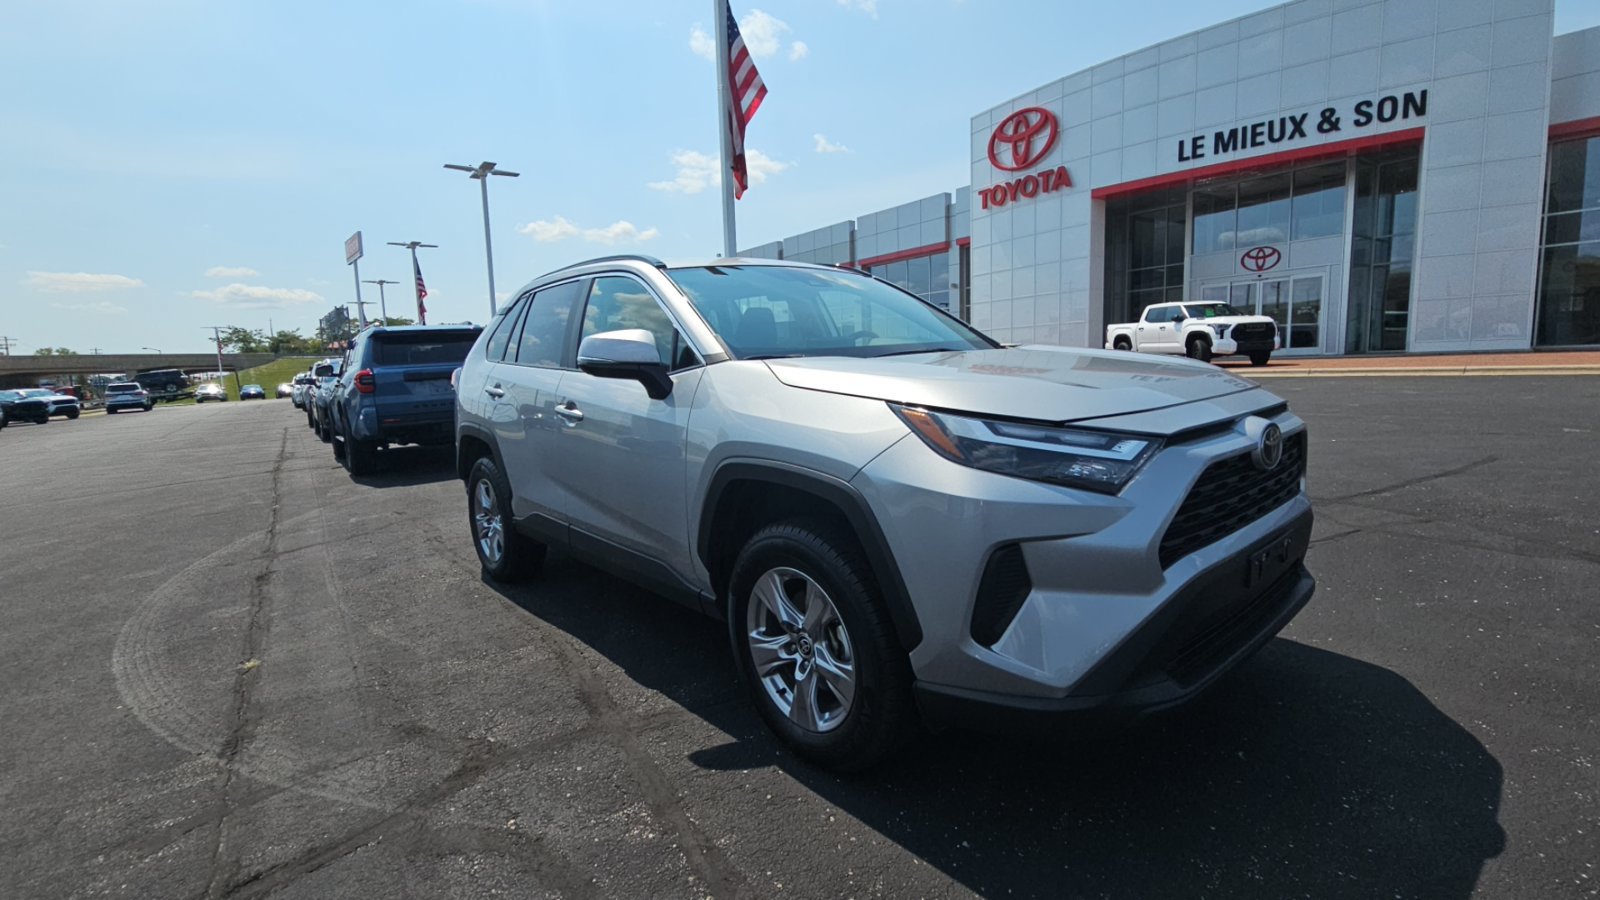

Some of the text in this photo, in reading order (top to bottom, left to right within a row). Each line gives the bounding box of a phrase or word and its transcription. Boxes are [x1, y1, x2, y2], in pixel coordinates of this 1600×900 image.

[1178, 89, 1428, 162] LE MIEUX & SON
[978, 166, 1072, 210] TOYOTA
